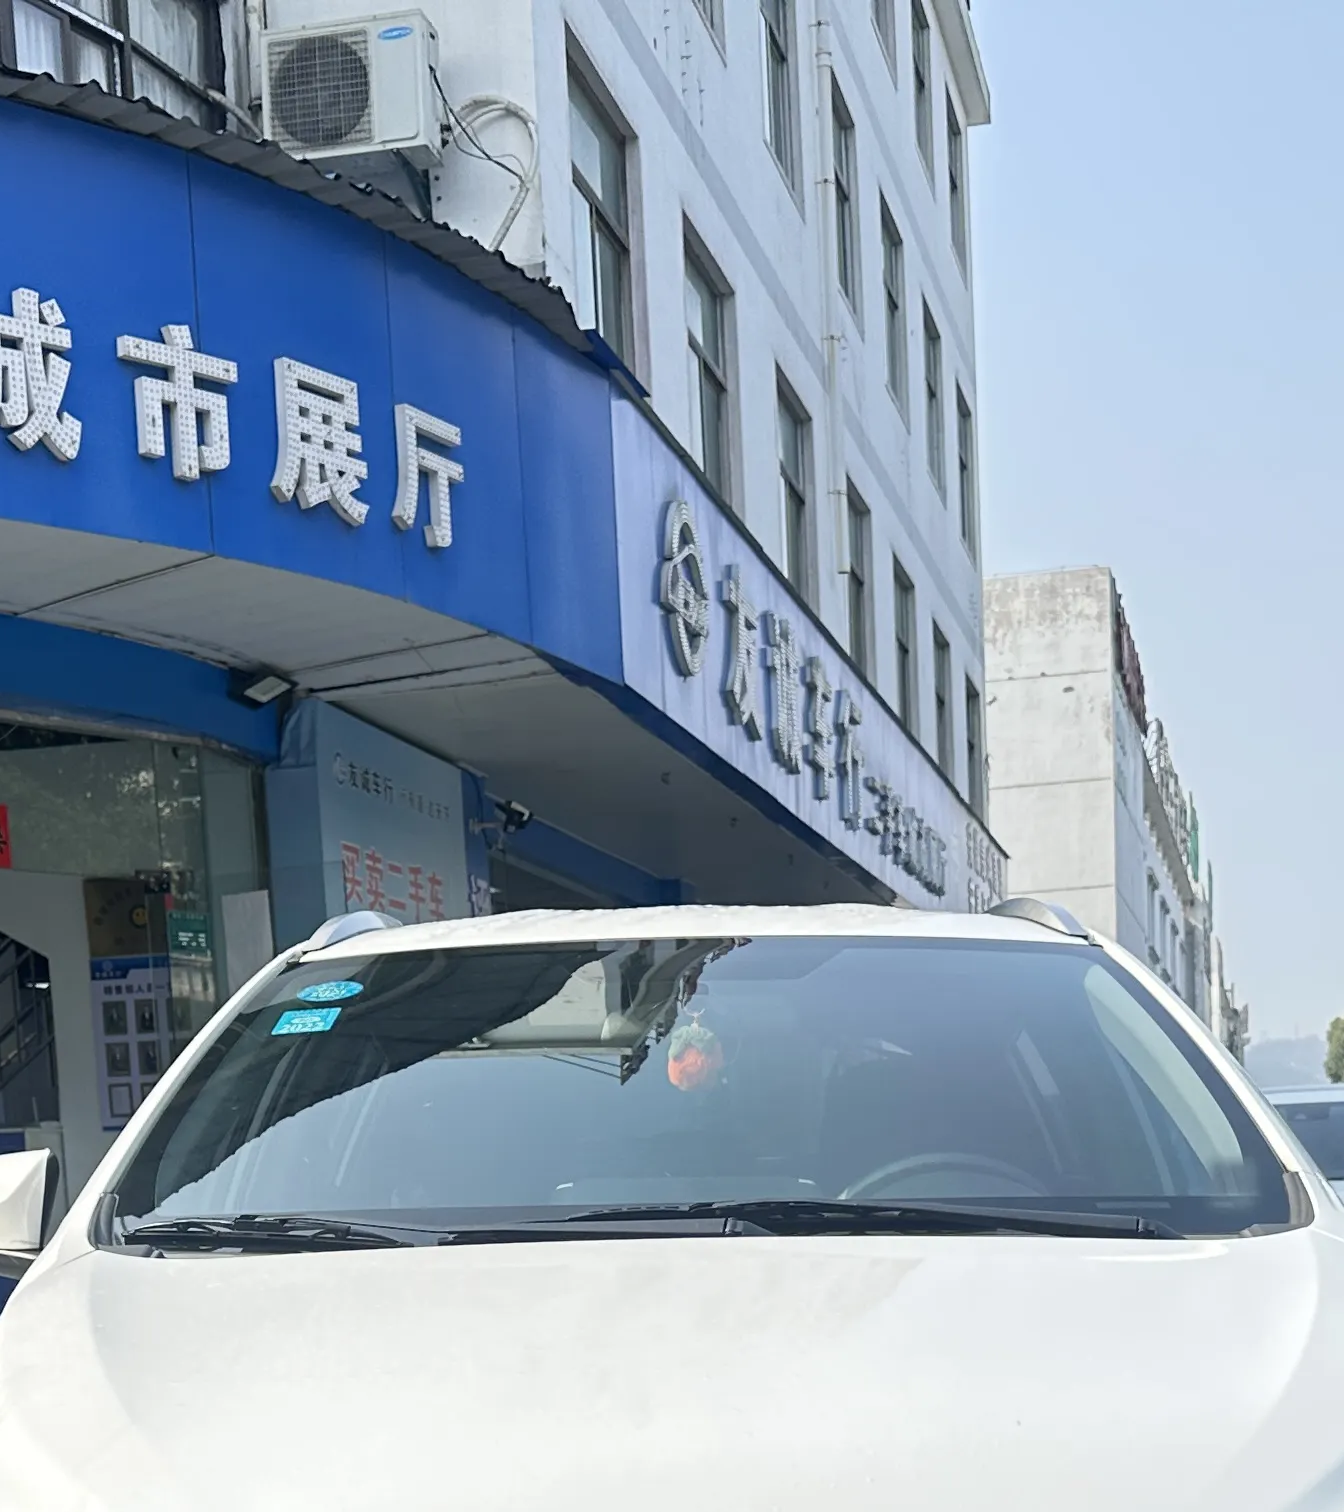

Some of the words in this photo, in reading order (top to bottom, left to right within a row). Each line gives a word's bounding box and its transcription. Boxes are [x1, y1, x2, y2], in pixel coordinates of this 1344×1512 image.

[340, 840, 446, 922] 买卖二手车
